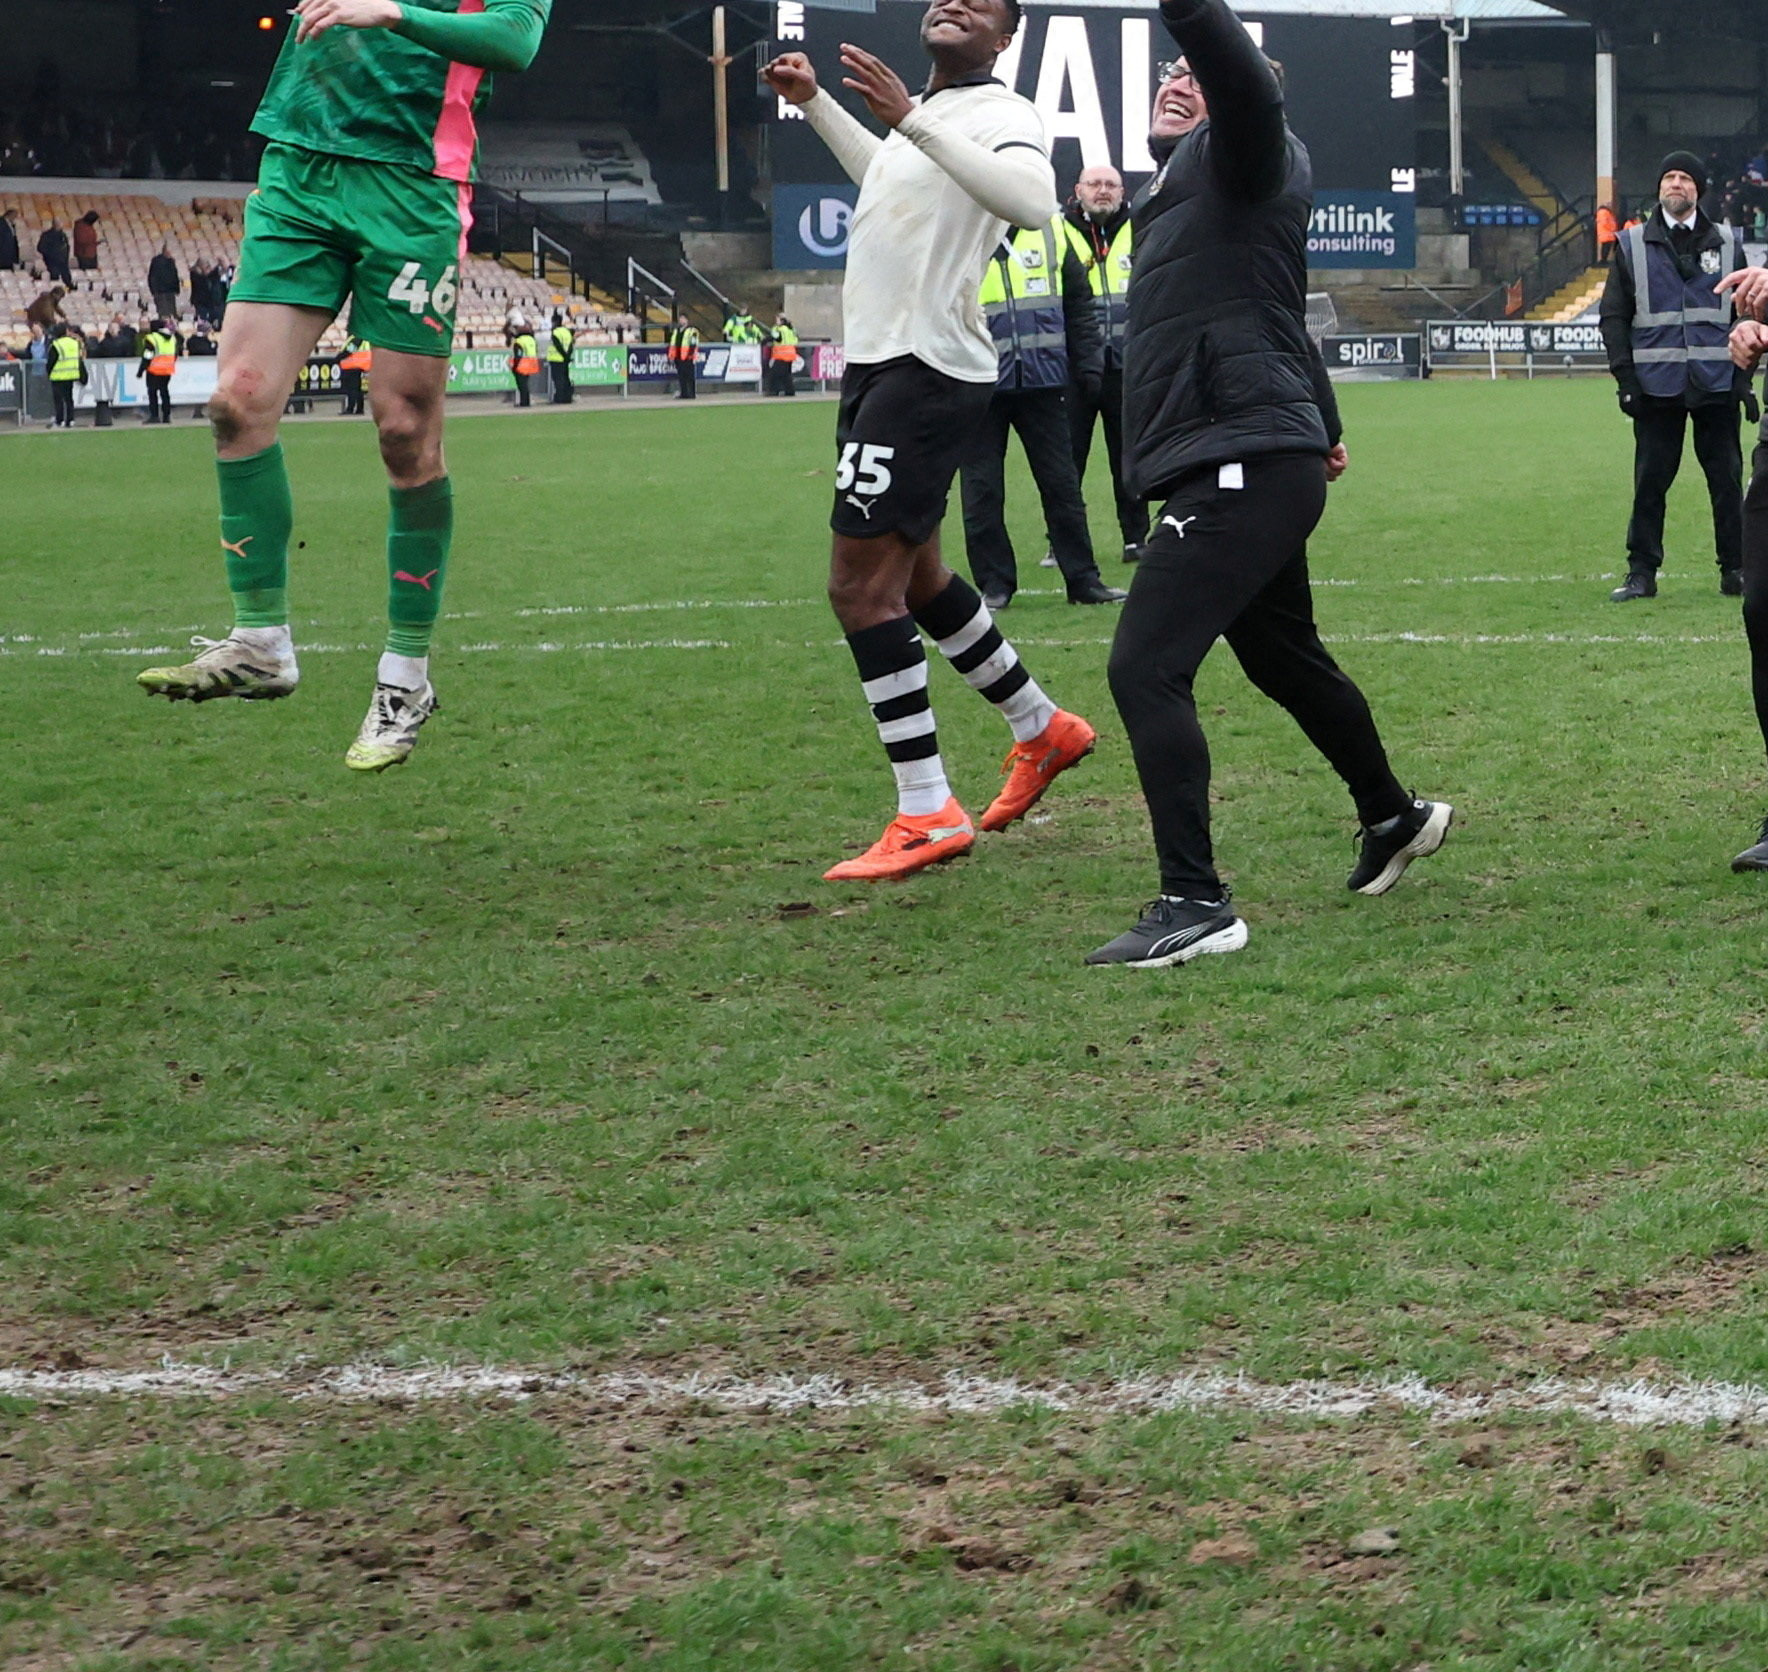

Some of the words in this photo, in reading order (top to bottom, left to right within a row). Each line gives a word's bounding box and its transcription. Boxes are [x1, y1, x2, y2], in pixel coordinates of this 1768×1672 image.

[1307, 204, 1395, 234] tilink
[1307, 235, 1395, 255] onsulting
[388, 261, 456, 315] 46
[1454, 326, 1525, 342] FOODHUB
[1553, 326, 1604, 342] FOODH
[475, 354, 510, 374] LEEK
[574, 350, 608, 368] LEEK
[819, 360, 845, 378] FRE
[835, 441, 895, 496] 35
